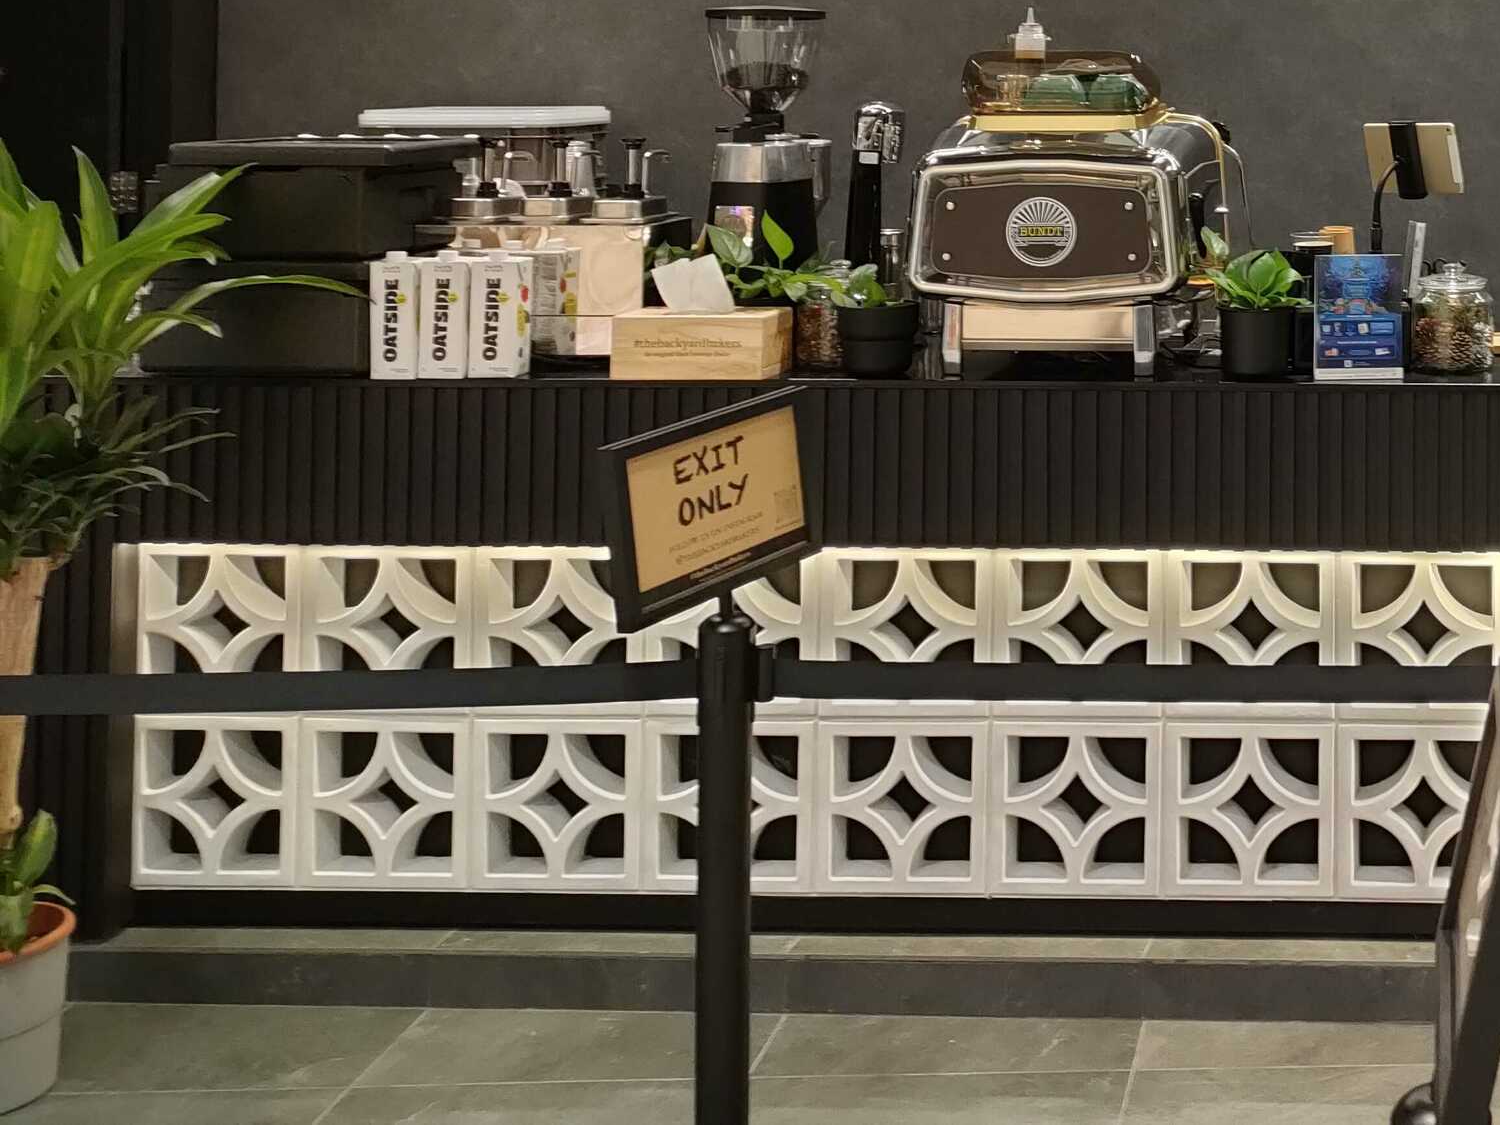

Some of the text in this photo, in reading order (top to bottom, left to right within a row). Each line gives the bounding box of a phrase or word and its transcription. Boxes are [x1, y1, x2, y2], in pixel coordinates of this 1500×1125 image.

[1020, 226, 1063, 236] BUNDT
[382, 278, 400, 362] OATSIDE
[432, 278, 451, 361] OATSIDE
[482, 278, 501, 361] OATSIDE
[673, 434, 744, 485] EXIT
[677, 473, 749, 526] ONLY
